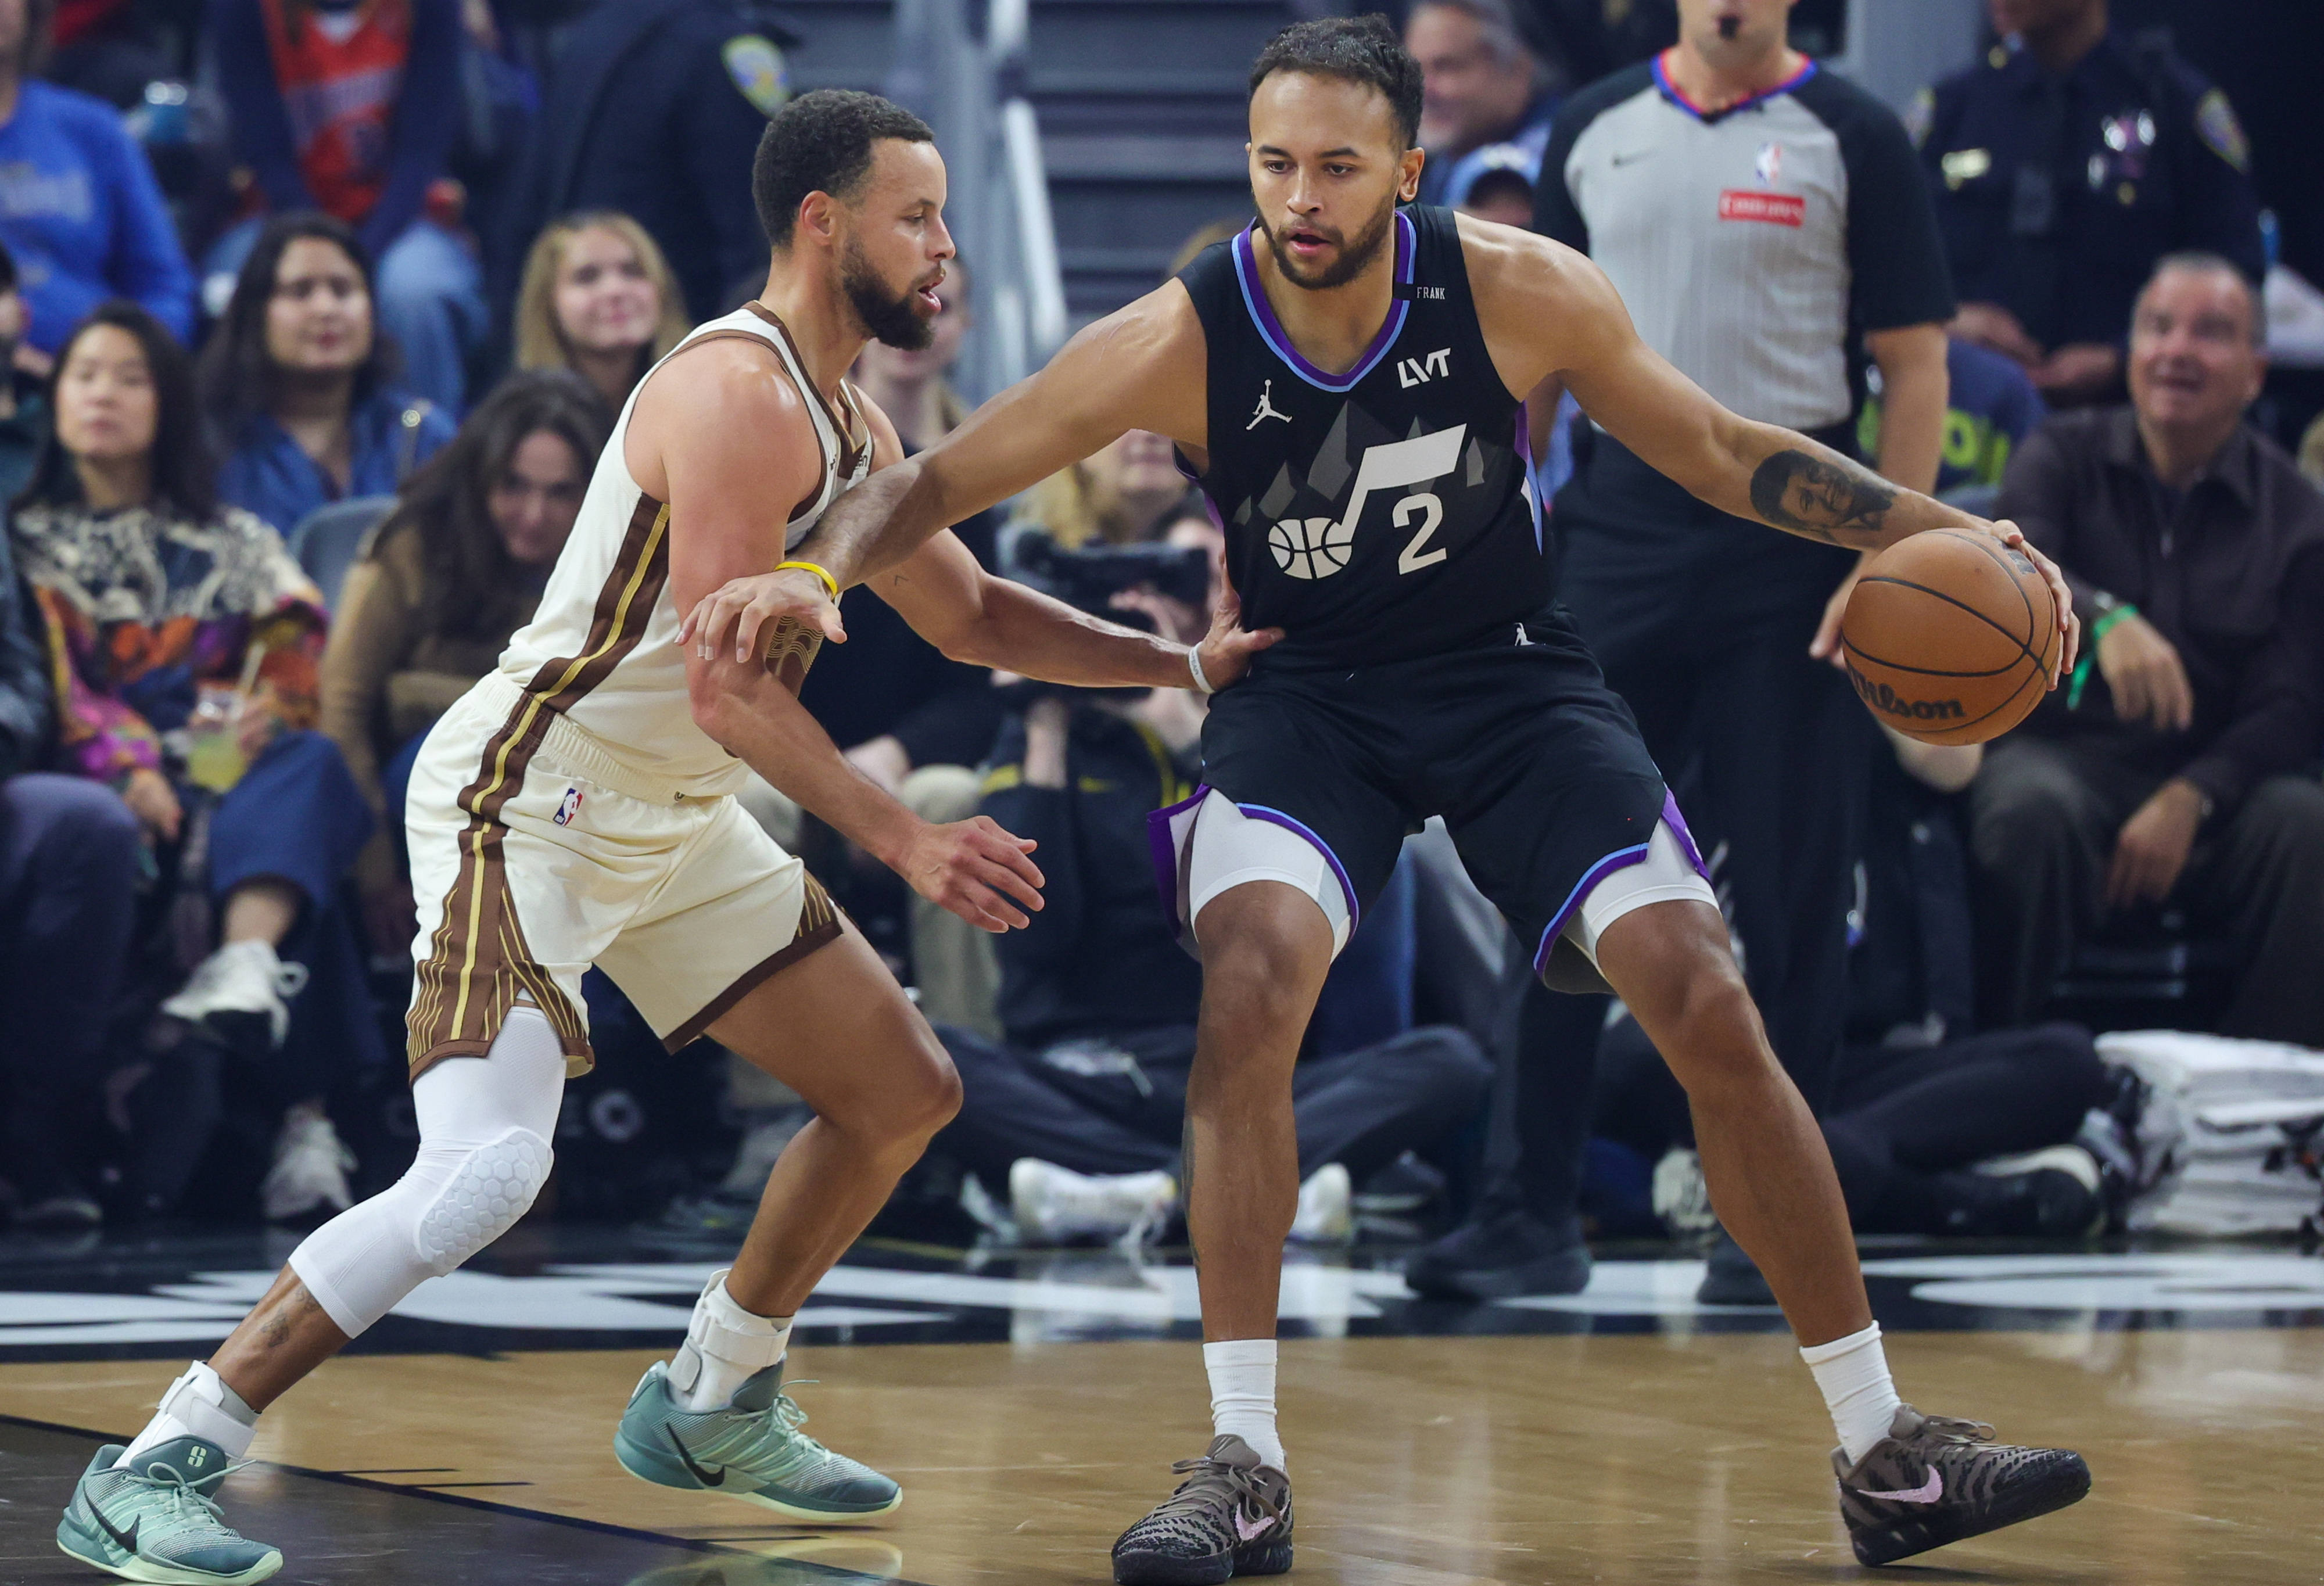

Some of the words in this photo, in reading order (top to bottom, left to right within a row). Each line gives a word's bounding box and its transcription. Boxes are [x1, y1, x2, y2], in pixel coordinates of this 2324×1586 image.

[1416, 286, 1446, 300] FRANK
[1397, 347, 1451, 389] LVT
[1392, 493, 1447, 575] 2
